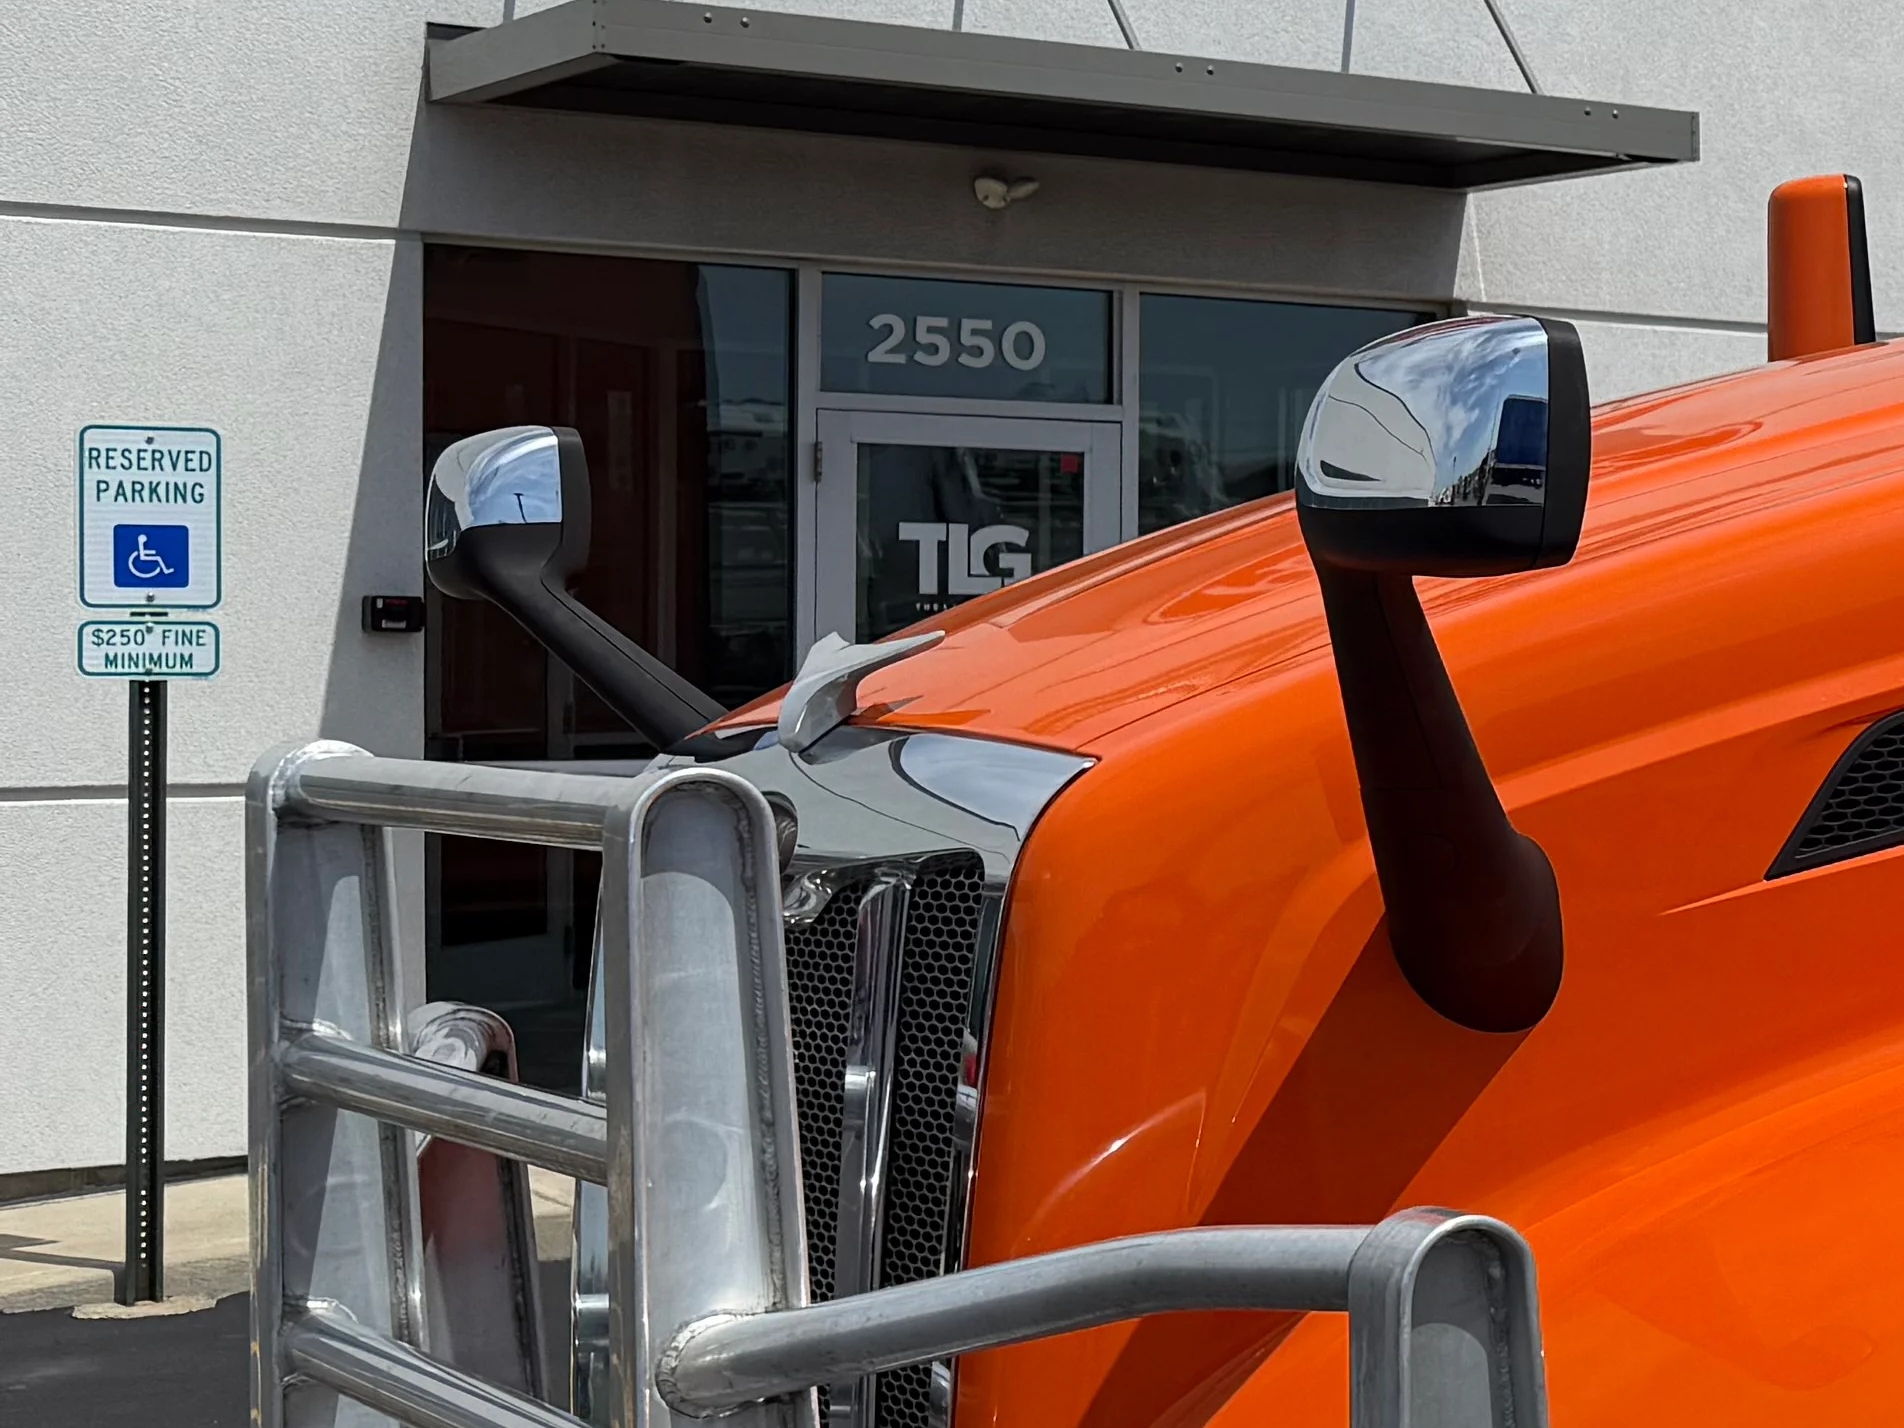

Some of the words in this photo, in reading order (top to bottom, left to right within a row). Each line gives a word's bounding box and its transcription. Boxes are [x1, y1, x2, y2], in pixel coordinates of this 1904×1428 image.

[867, 313, 1046, 371] 2550
[88, 447, 212, 472] RESERVED
[96, 480, 205, 504] PARKING
[898, 522, 1032, 595] TLG
[91, 628, 146, 647] $250
[161, 629, 207, 646] FINE
[104, 652, 194, 670] MINIMUM
